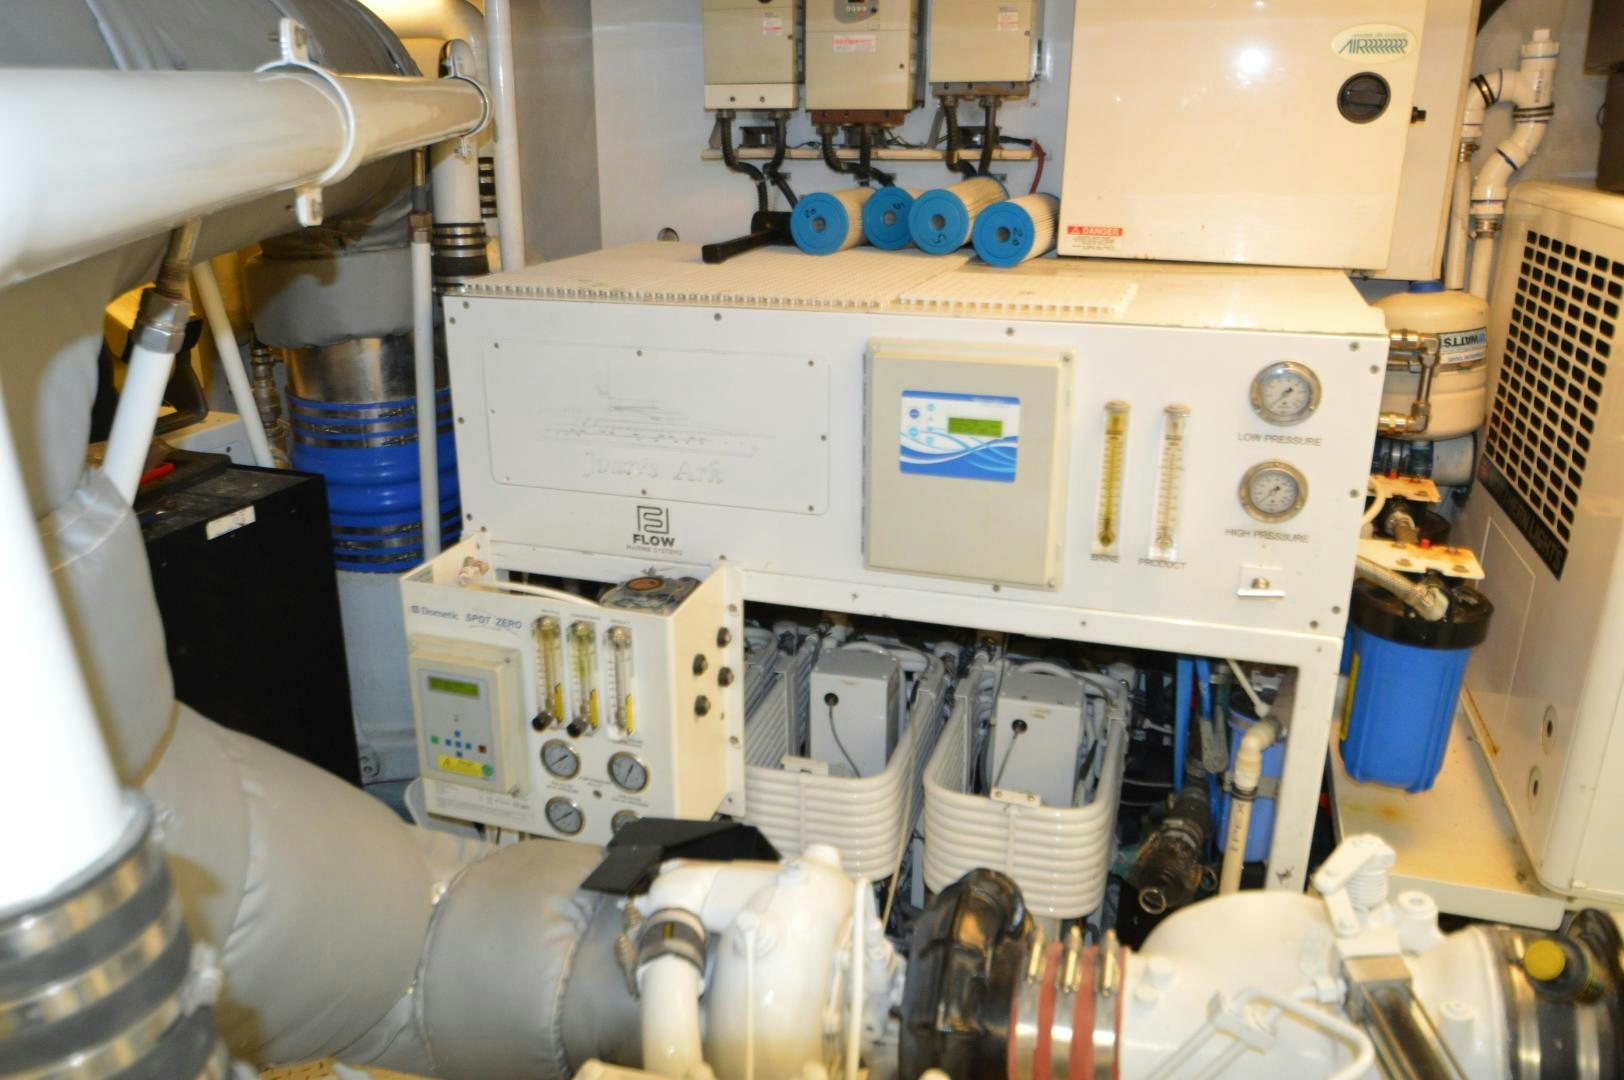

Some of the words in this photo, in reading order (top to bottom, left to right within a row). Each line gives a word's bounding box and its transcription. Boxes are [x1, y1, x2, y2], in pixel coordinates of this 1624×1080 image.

[1082, 226, 1119, 236] DANGER
[1443, 334, 1478, 348] WATTS
[1237, 432, 1261, 442] LOW
[1264, 434, 1321, 447] PRESSURE
[633, 534, 675, 548] FLOW
[1225, 528, 1251, 538] HIGH
[1254, 530, 1310, 544] PRESSURE
[1138, 558, 1187, 570] PRODUCT
[465, 613, 491, 624] SPOT
[495, 617, 522, 629] ZERO
